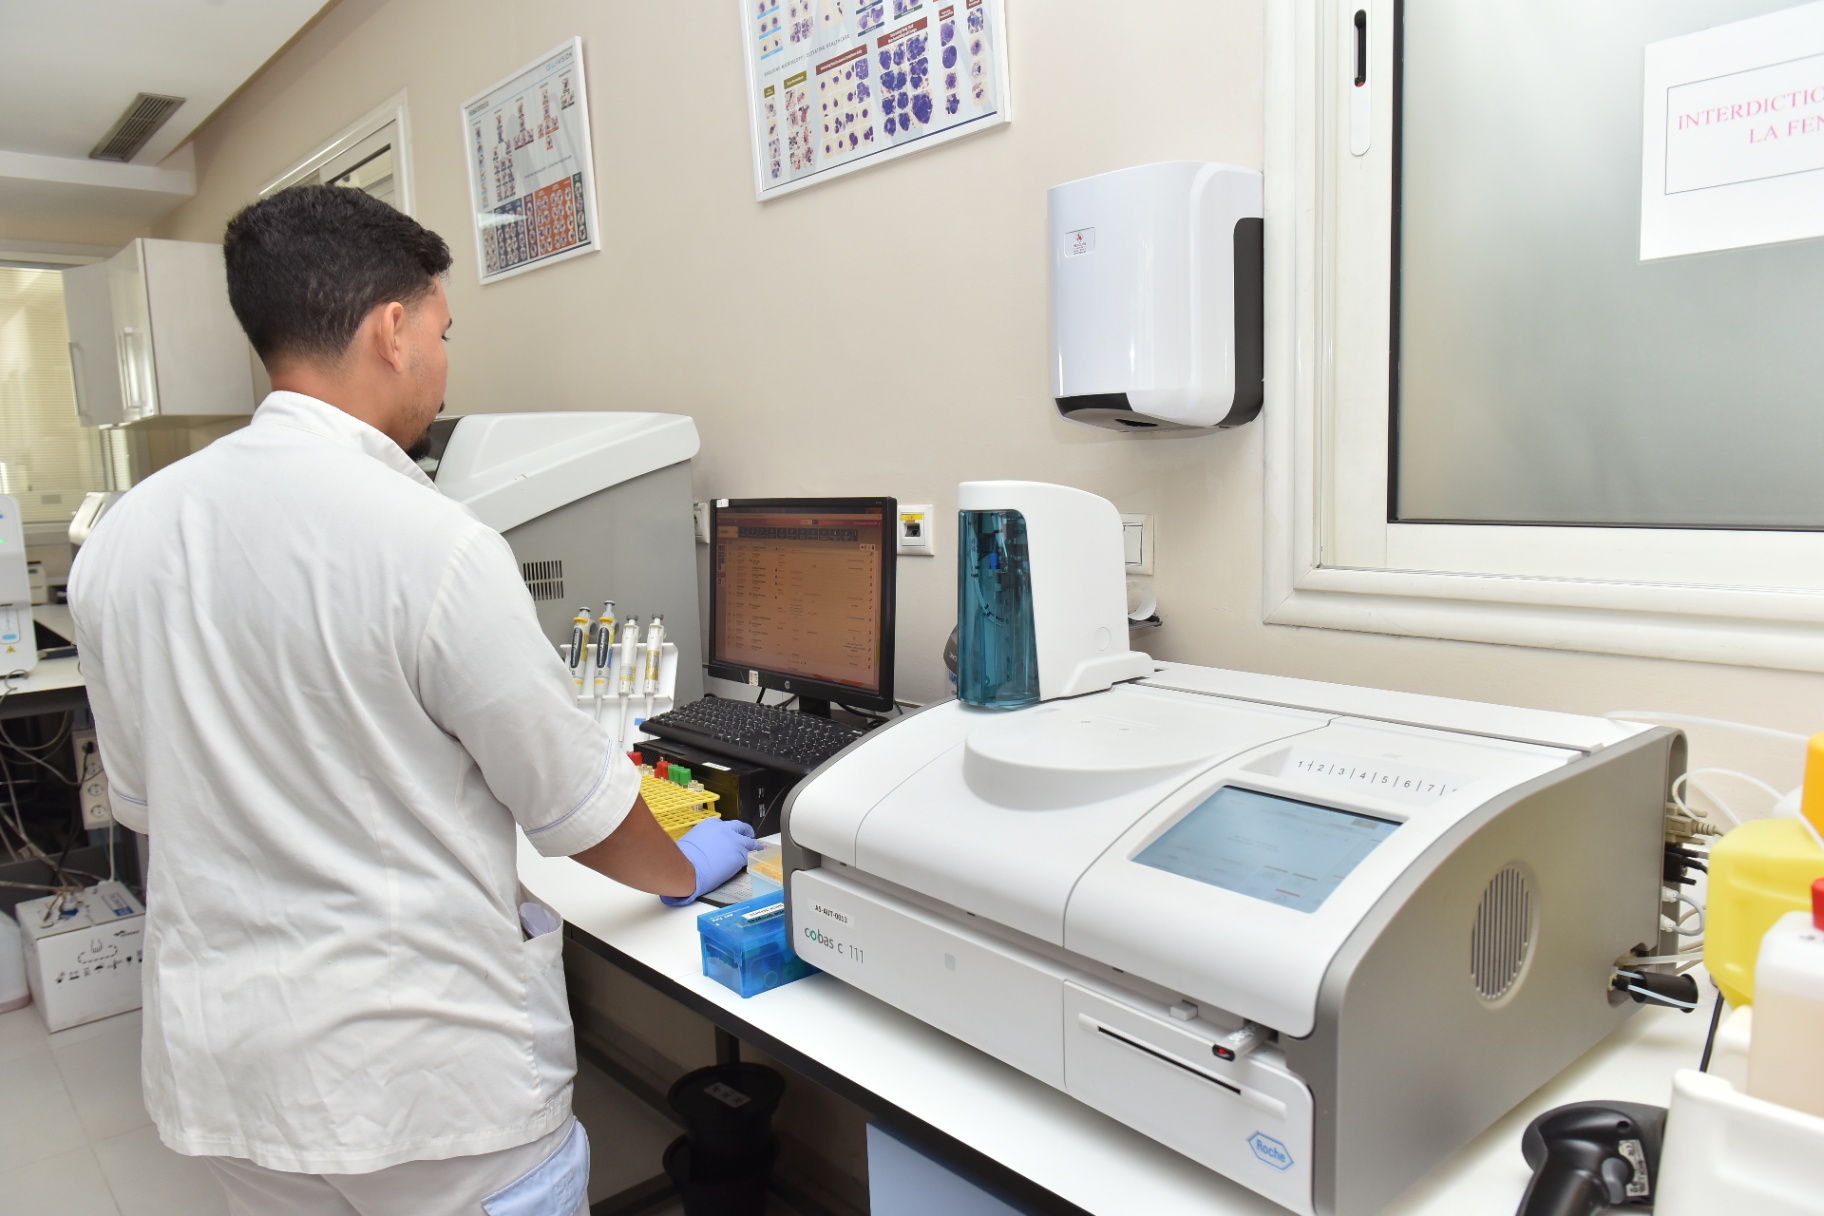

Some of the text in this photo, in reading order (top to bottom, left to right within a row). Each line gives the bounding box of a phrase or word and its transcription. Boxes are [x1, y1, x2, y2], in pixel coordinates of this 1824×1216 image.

[1749, 125, 1779, 144] LA
[1298, 760, 1435, 792] 1 2 3 4 5 6 7
[804, 927, 864, 964] cobas c 111
[1256, 1139, 1286, 1163] Roche
